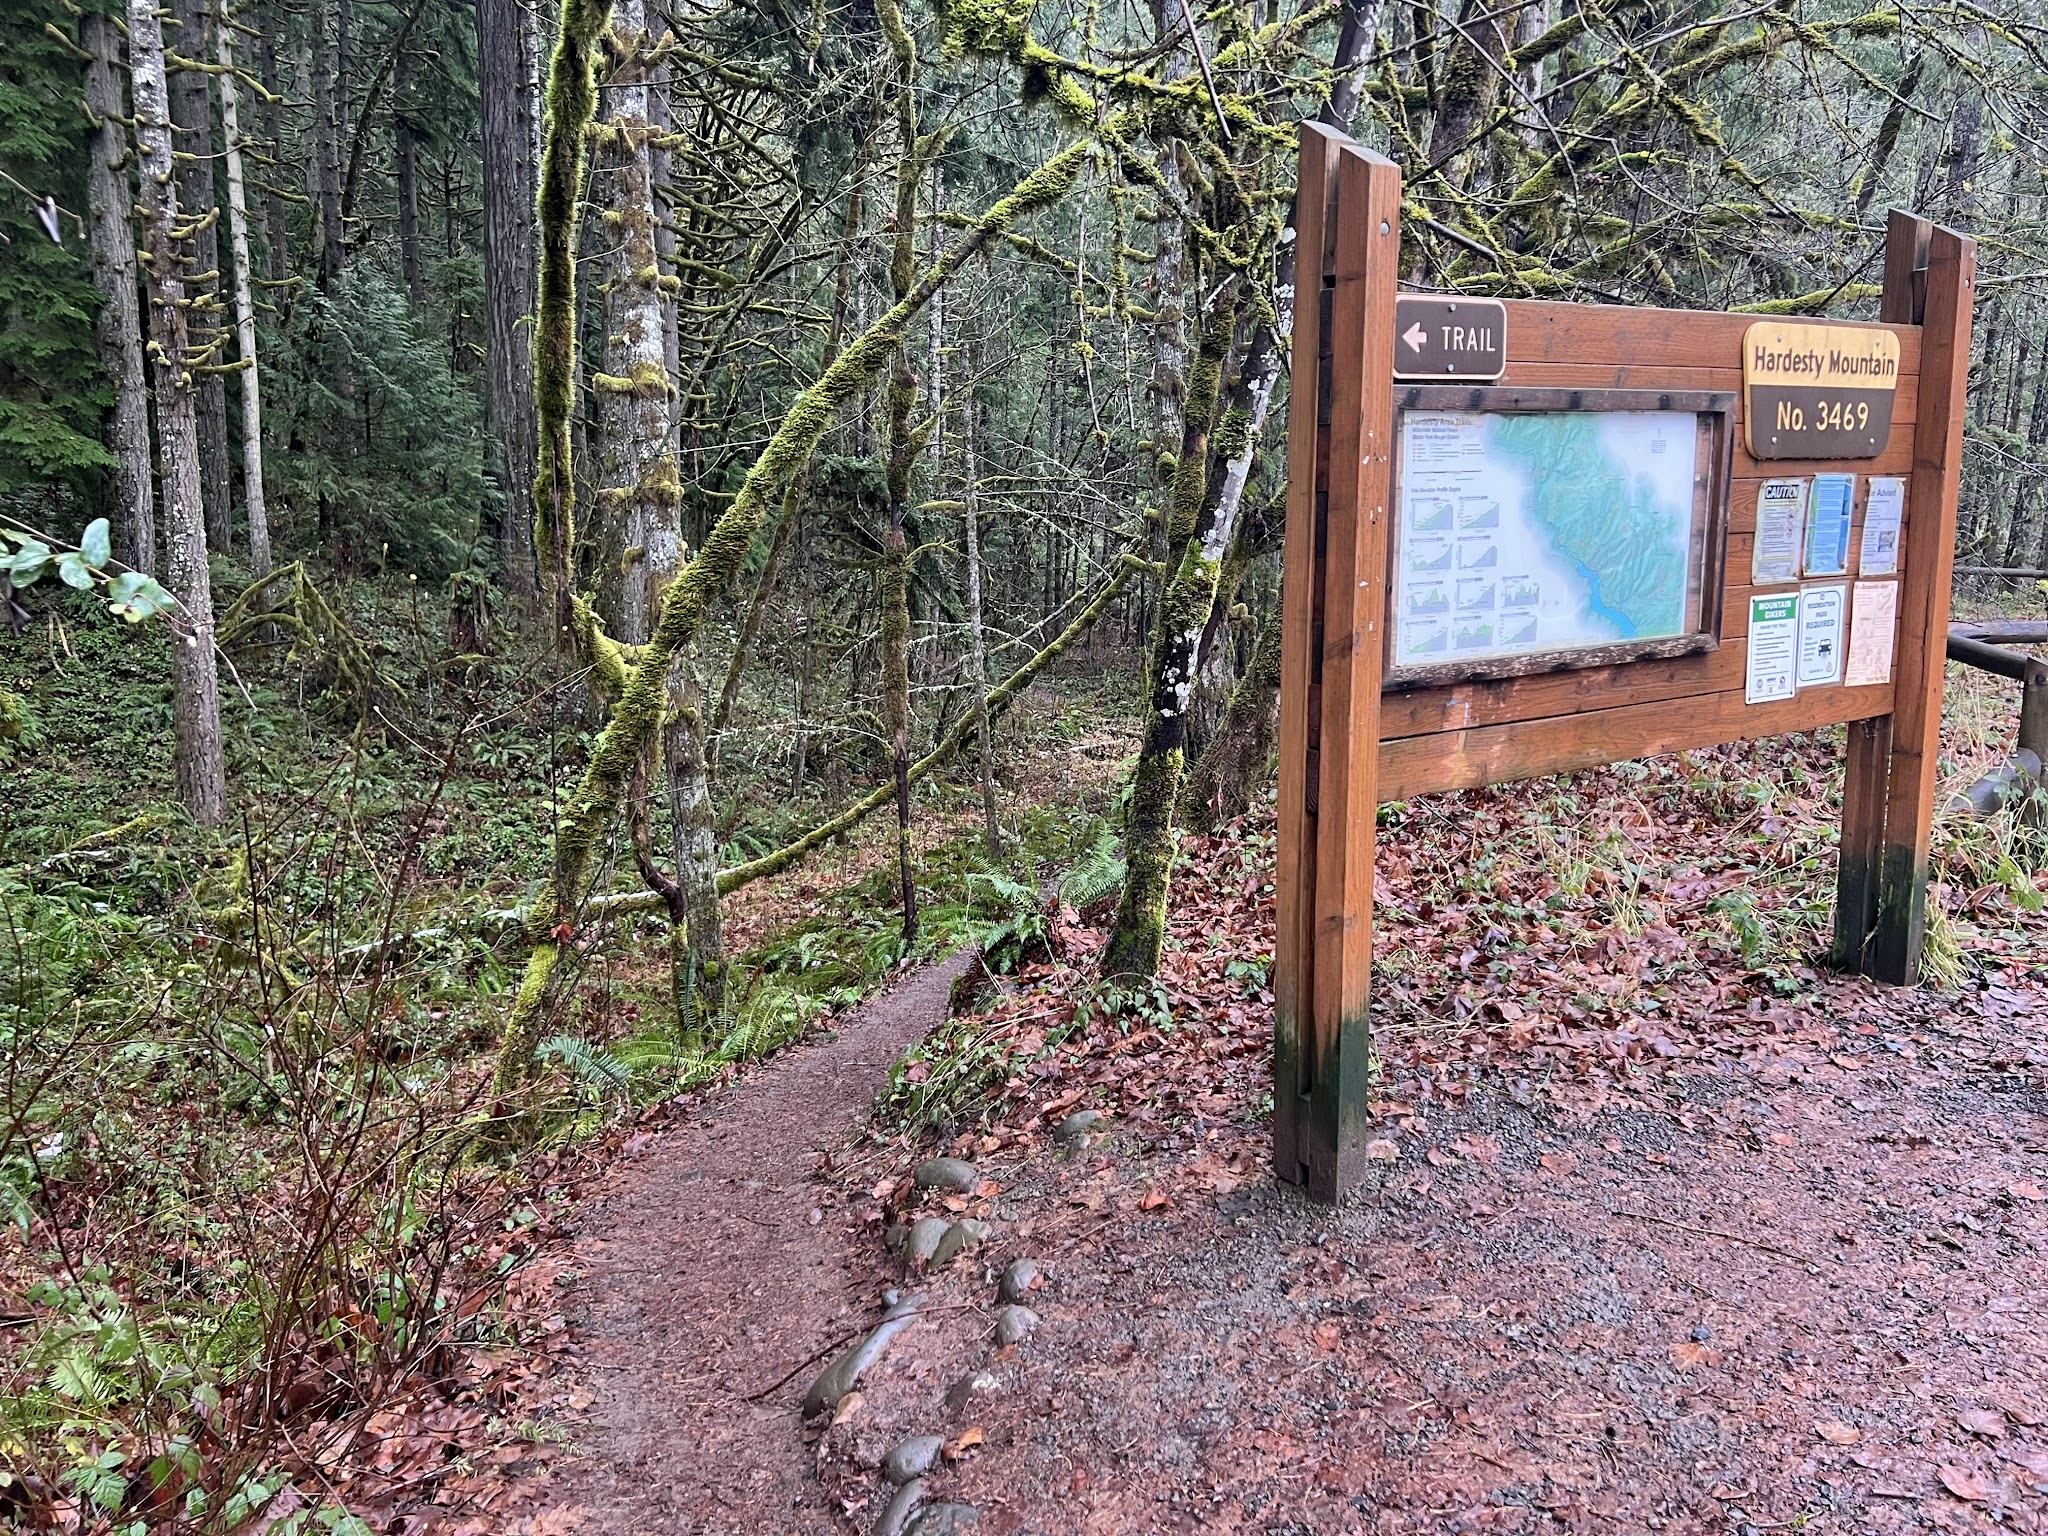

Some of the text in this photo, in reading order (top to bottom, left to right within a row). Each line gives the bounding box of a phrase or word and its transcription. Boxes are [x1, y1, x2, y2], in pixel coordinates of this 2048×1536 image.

[1441, 326, 1496, 351] TRAIL
[1754, 346, 1895, 379] Hardesty Mountain
[1776, 400, 1869, 431] No. 3469
[1765, 485, 1798, 499] CAUTION
[1758, 600, 1792, 610] MOUNTAIN
[1807, 601, 1836, 609] RECREATION
[1764, 609, 1787, 619] BIKERS
[1805, 619, 1835, 629] REQUIRED
